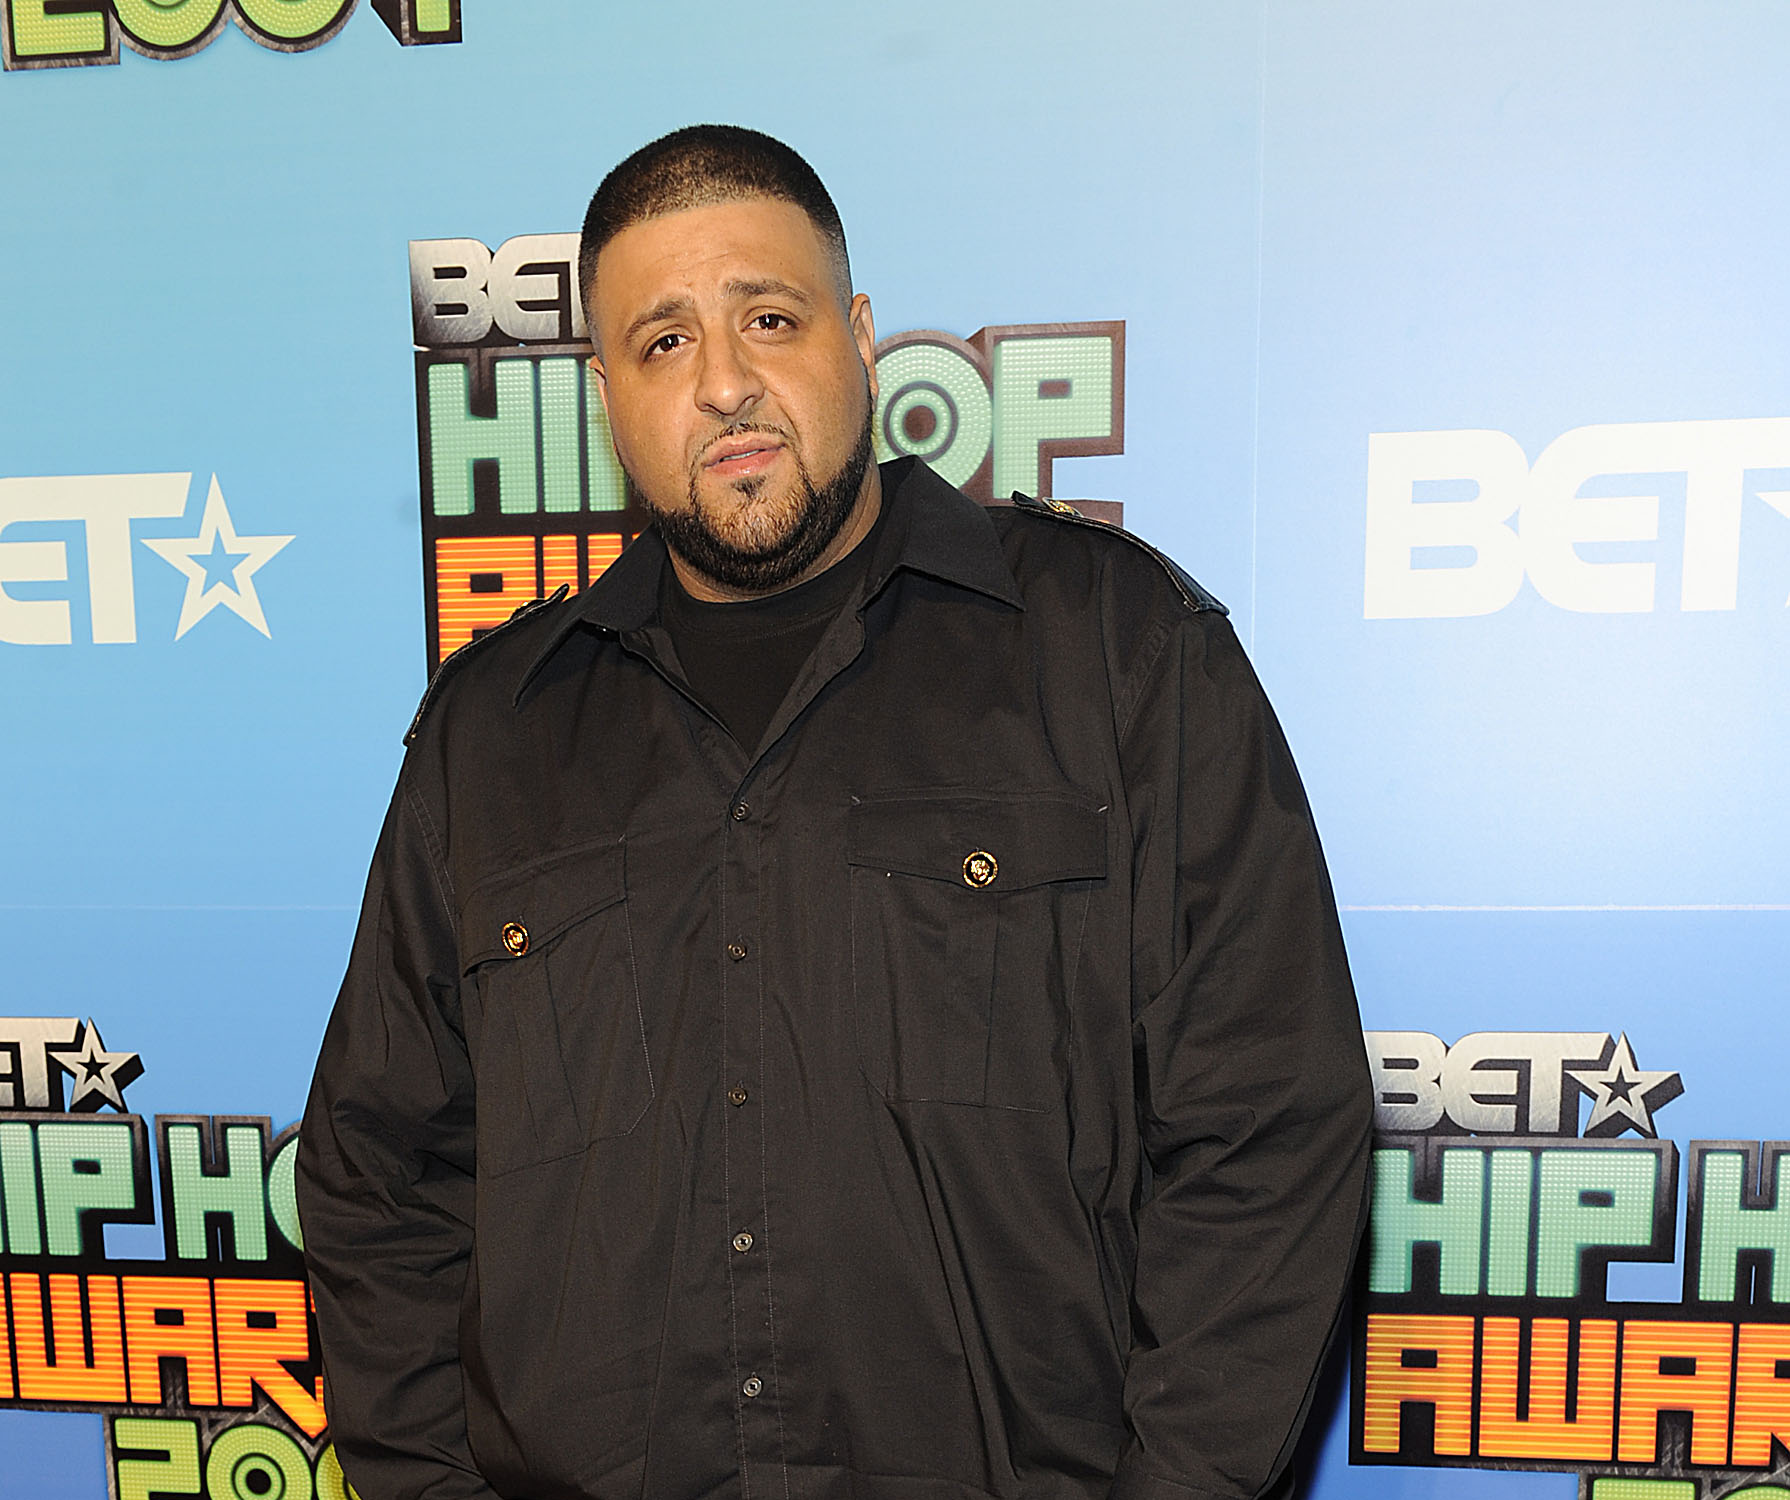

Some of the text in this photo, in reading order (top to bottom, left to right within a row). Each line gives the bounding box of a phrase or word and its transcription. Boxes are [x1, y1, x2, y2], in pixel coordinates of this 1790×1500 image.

[409, 232, 588, 344] BE
[1363, 416, 1790, 620] BET
[1364, 1030, 1611, 1133] BET
[1368, 1149, 1658, 1298] HIP
[0, 1271, 328, 1438] WAR
